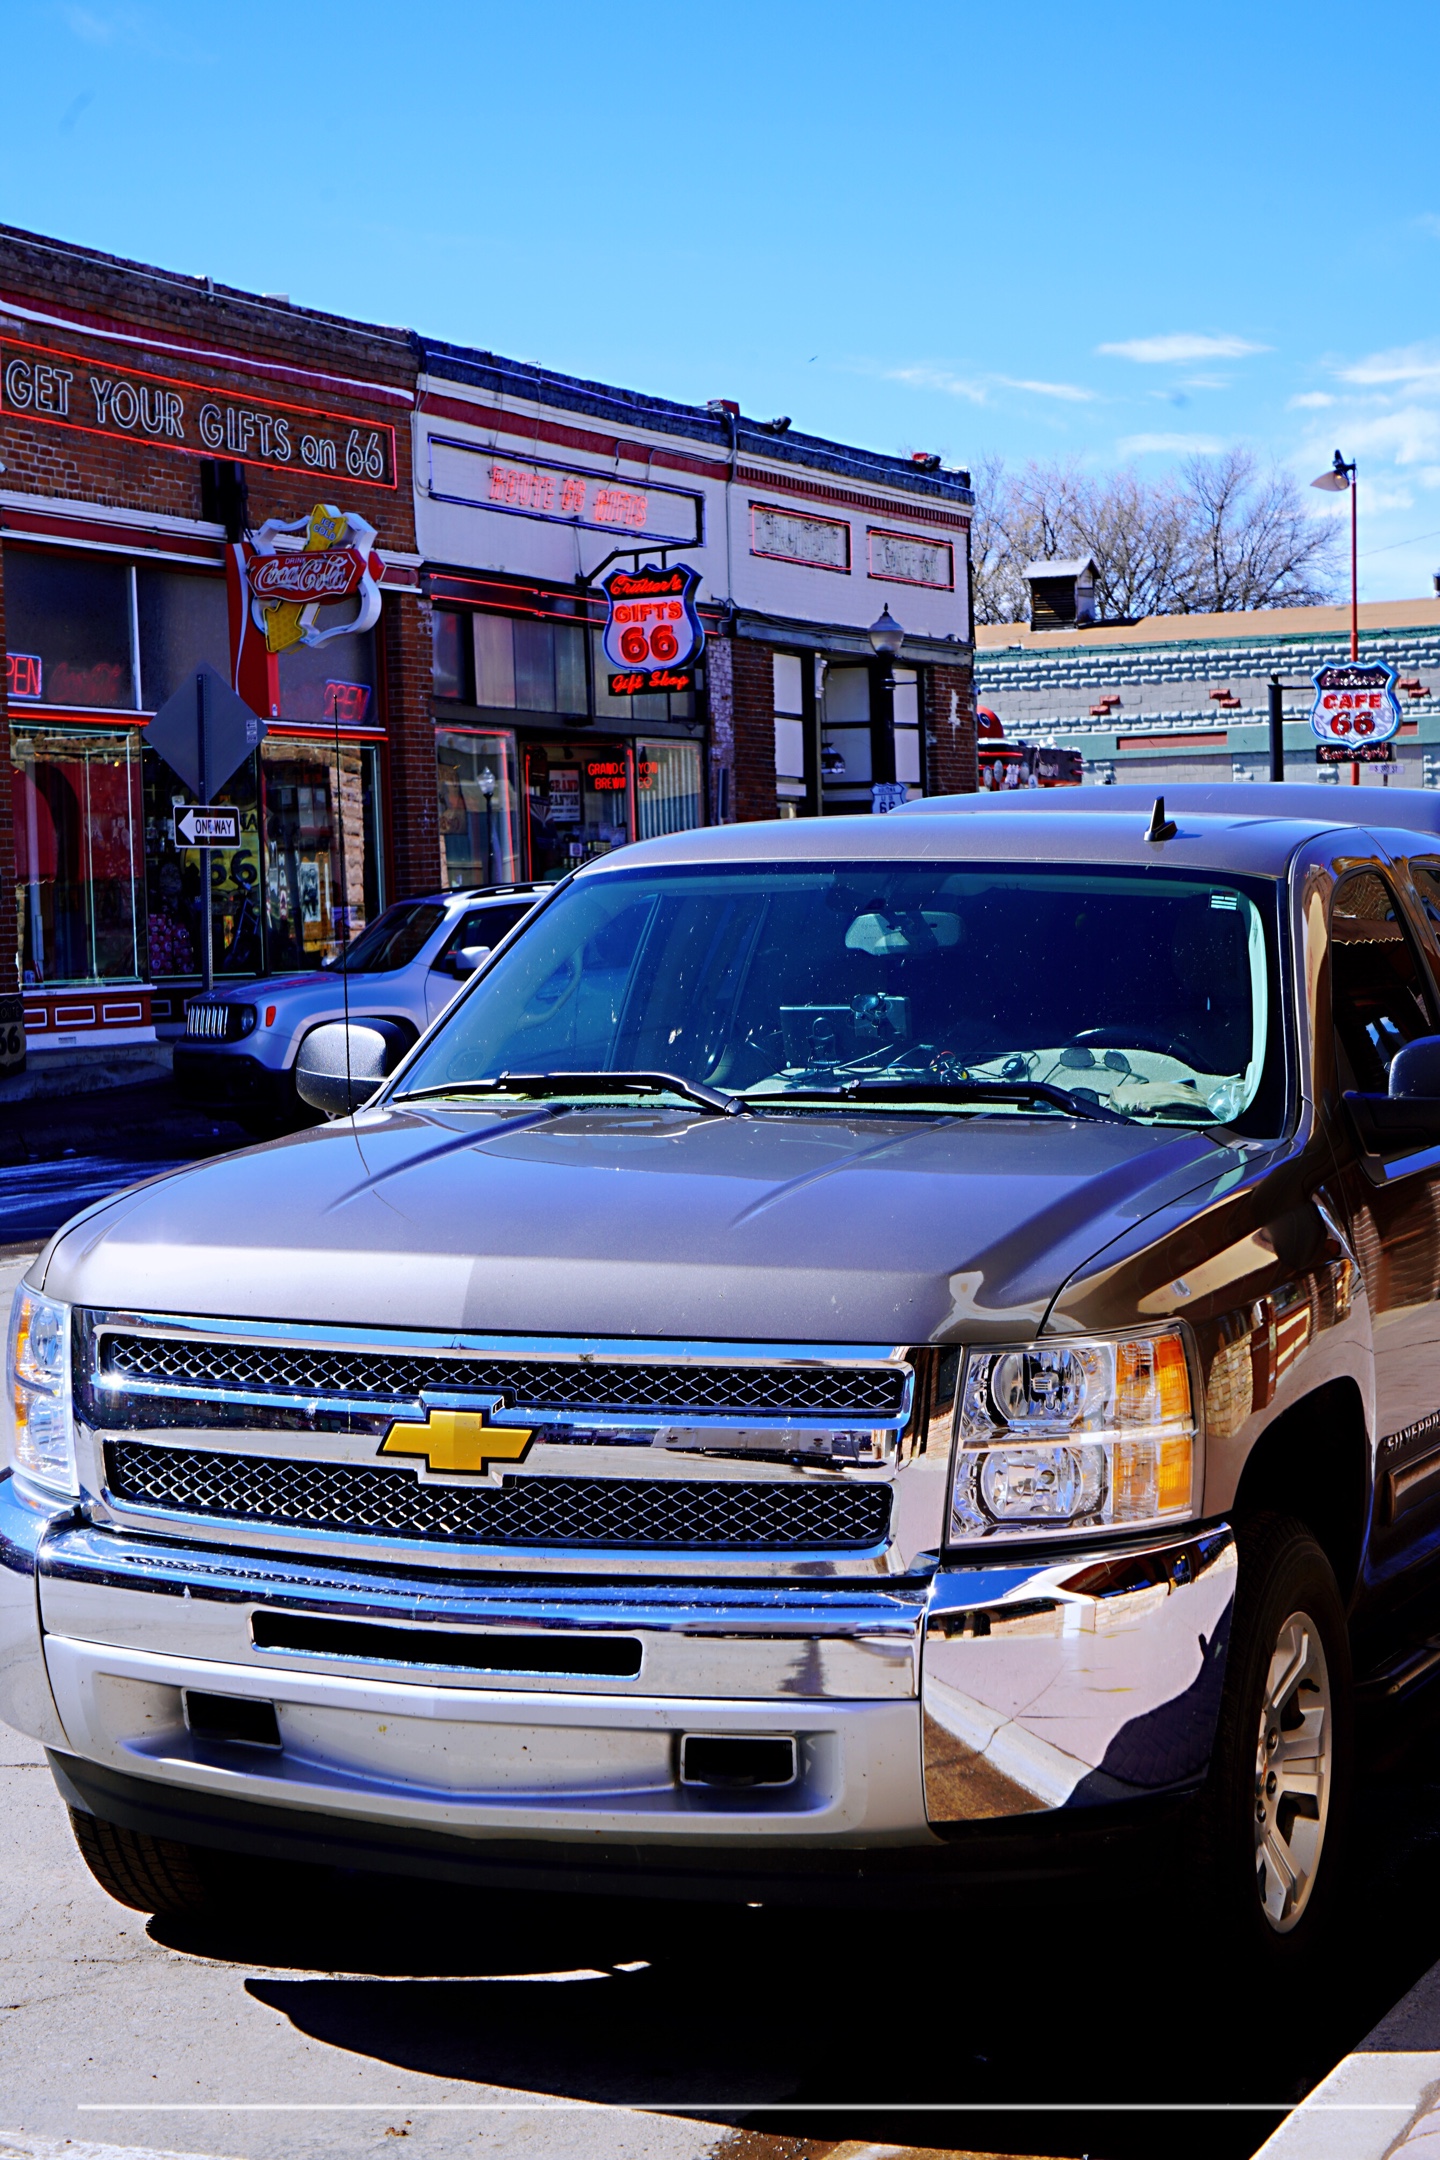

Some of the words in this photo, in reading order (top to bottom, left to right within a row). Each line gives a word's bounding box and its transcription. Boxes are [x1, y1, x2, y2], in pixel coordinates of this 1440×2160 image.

[6, 359, 73, 416] GET
[90, 376, 185, 438] YOUR
[199, 403, 292, 462] GIFTS
[301, 434, 337, 470] on
[345, 428, 385, 479] 66
[488, 465, 557, 510] ROUTE
[561, 479, 587, 512] 66
[594, 489, 649, 527] GIFTS
[313, 524, 337, 541] COLD
[321, 517, 336, 531] ICE
[285, 556, 307, 565] DRINK
[614, 601, 683, 623] GIFTS
[618, 624, 679, 663] 66
[612, 674, 644, 694] Gift
[649, 670, 690, 690] Shop
[323, 683, 370, 720] OPEN
[1323, 693, 1382, 710] CAFE
[1330, 711, 1376, 736] 66
[587, 762, 619, 776] GRAND
[195, 819, 213, 835] ONE
[213, 819, 233, 835] WAY
[1384, 1409, 1440, 1455] SILVERAD
